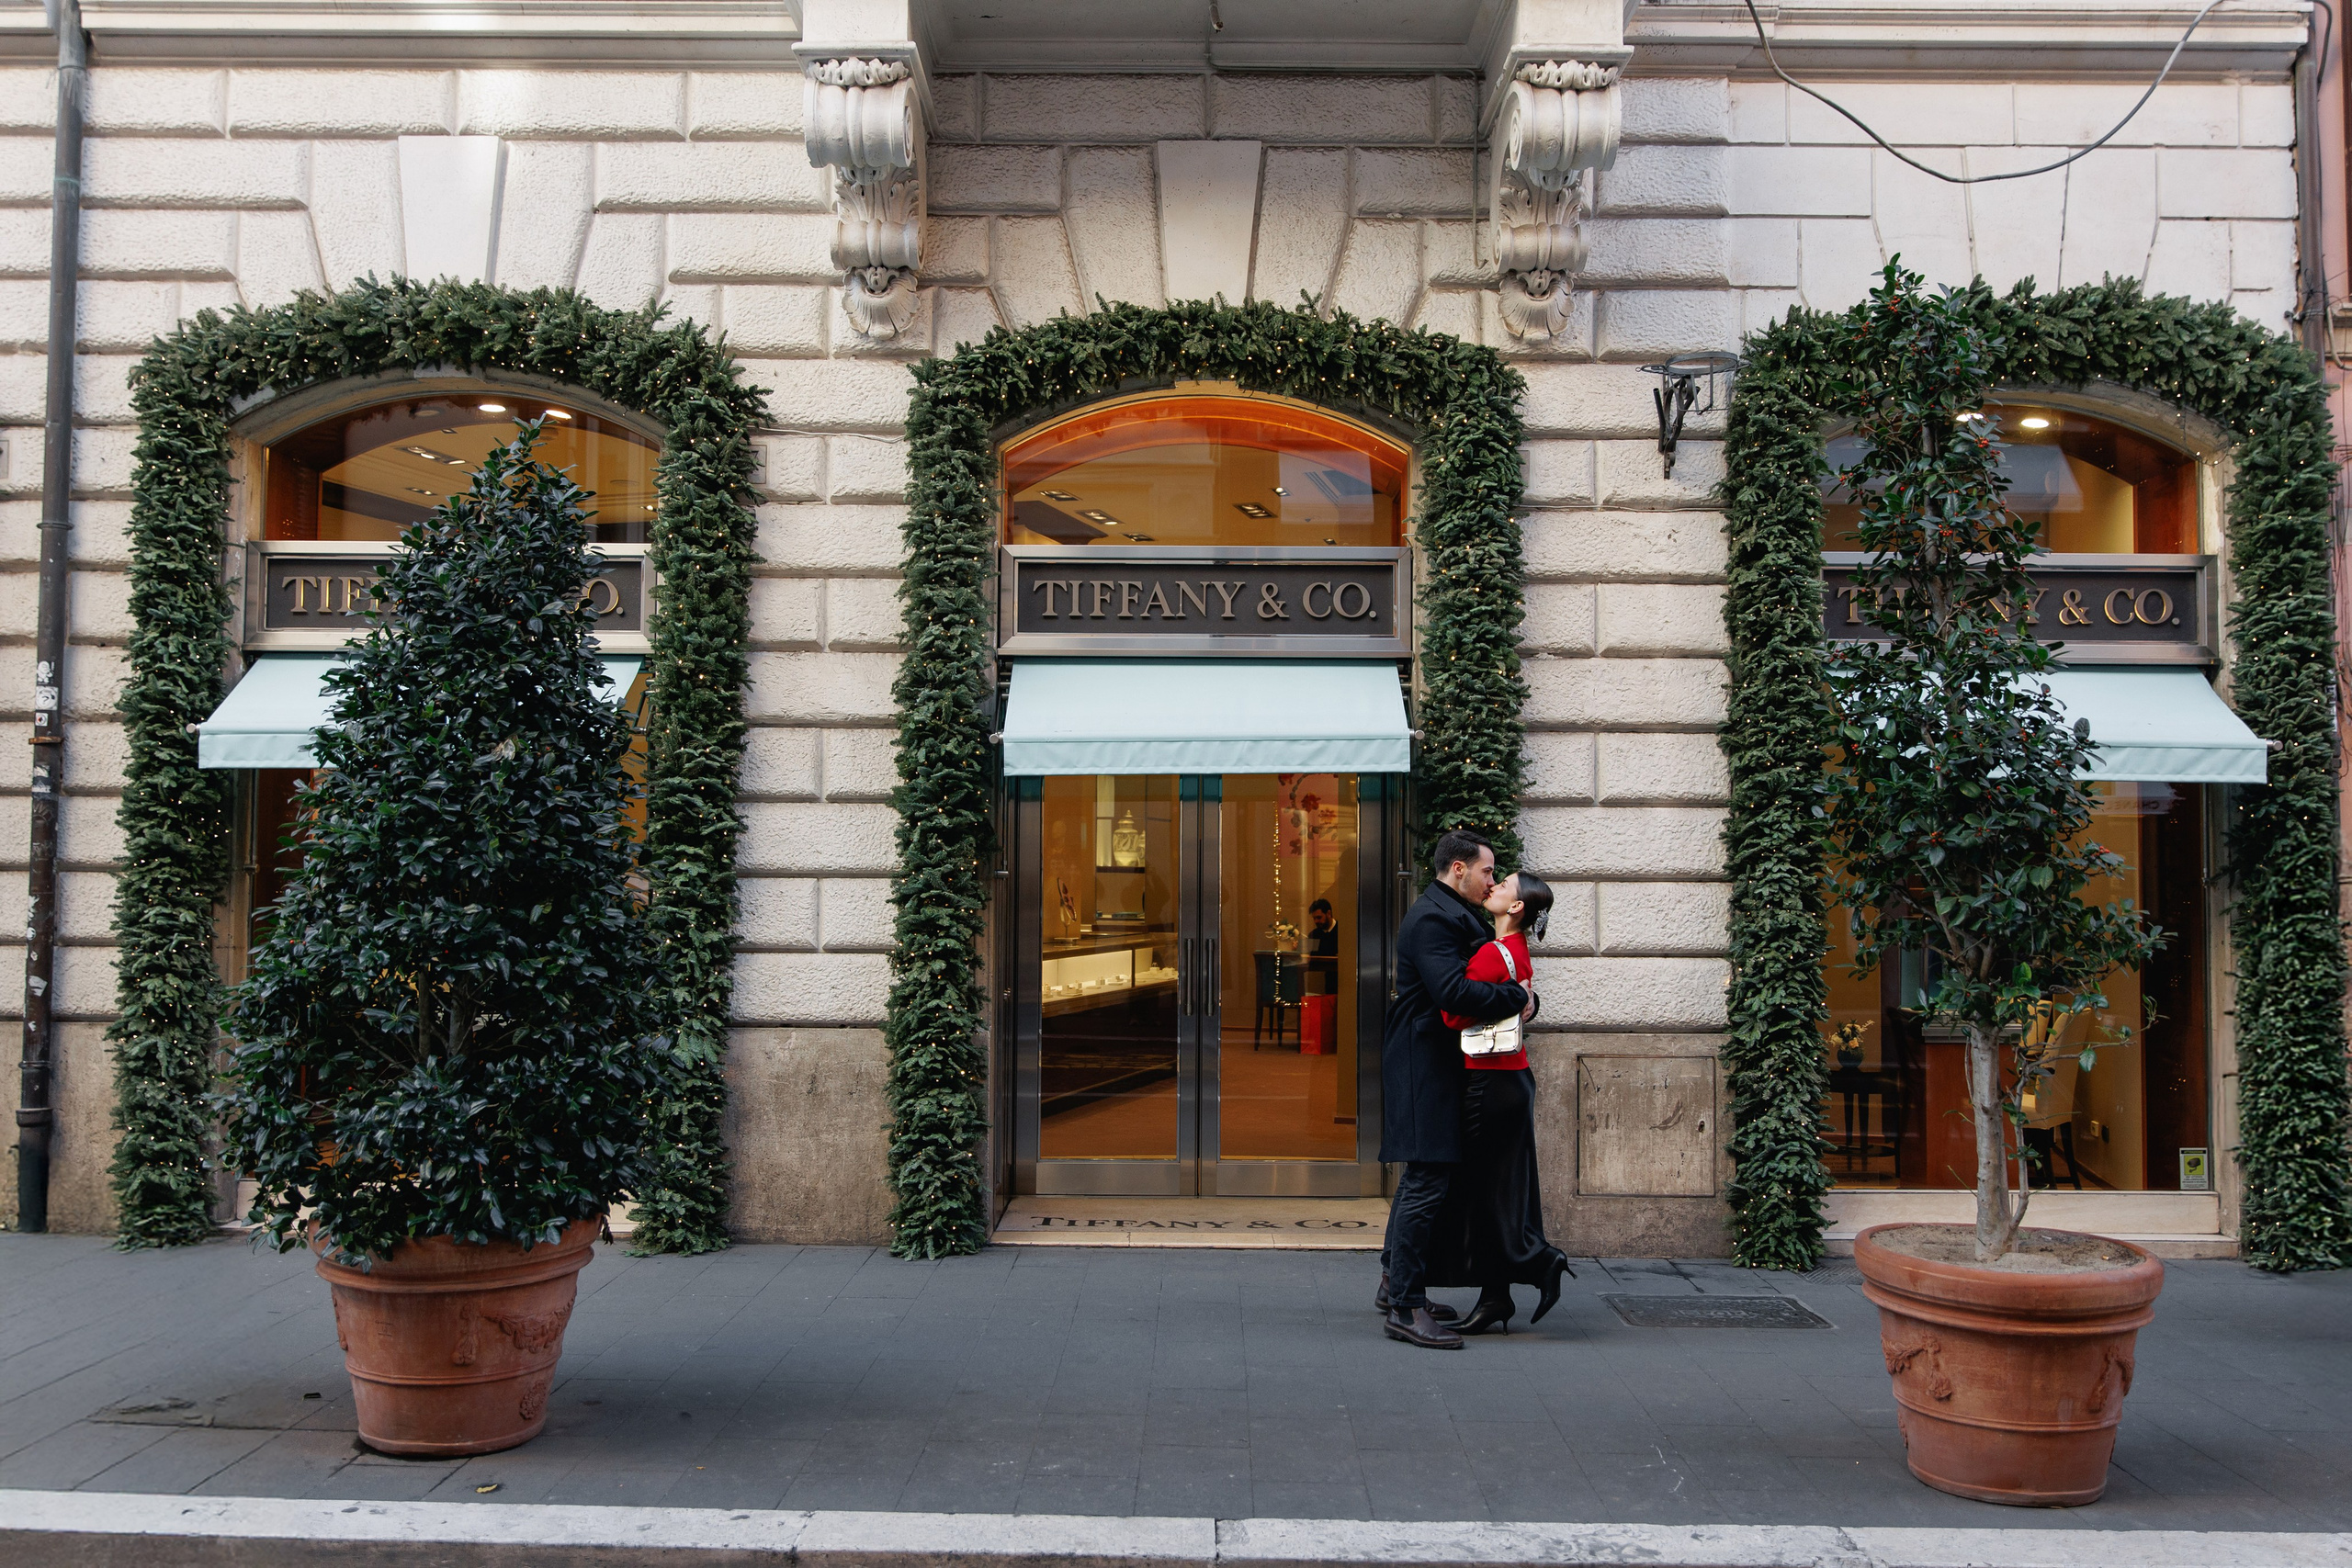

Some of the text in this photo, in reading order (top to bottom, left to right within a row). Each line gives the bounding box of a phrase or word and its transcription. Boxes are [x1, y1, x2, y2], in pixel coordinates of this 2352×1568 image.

[559, 576, 625, 615] O.
[1033, 580, 1377, 618] TIFFANY & CO.
[1837, 586, 2180, 626] TINY & CO.
[1246, 1220, 1284, 1229] &
